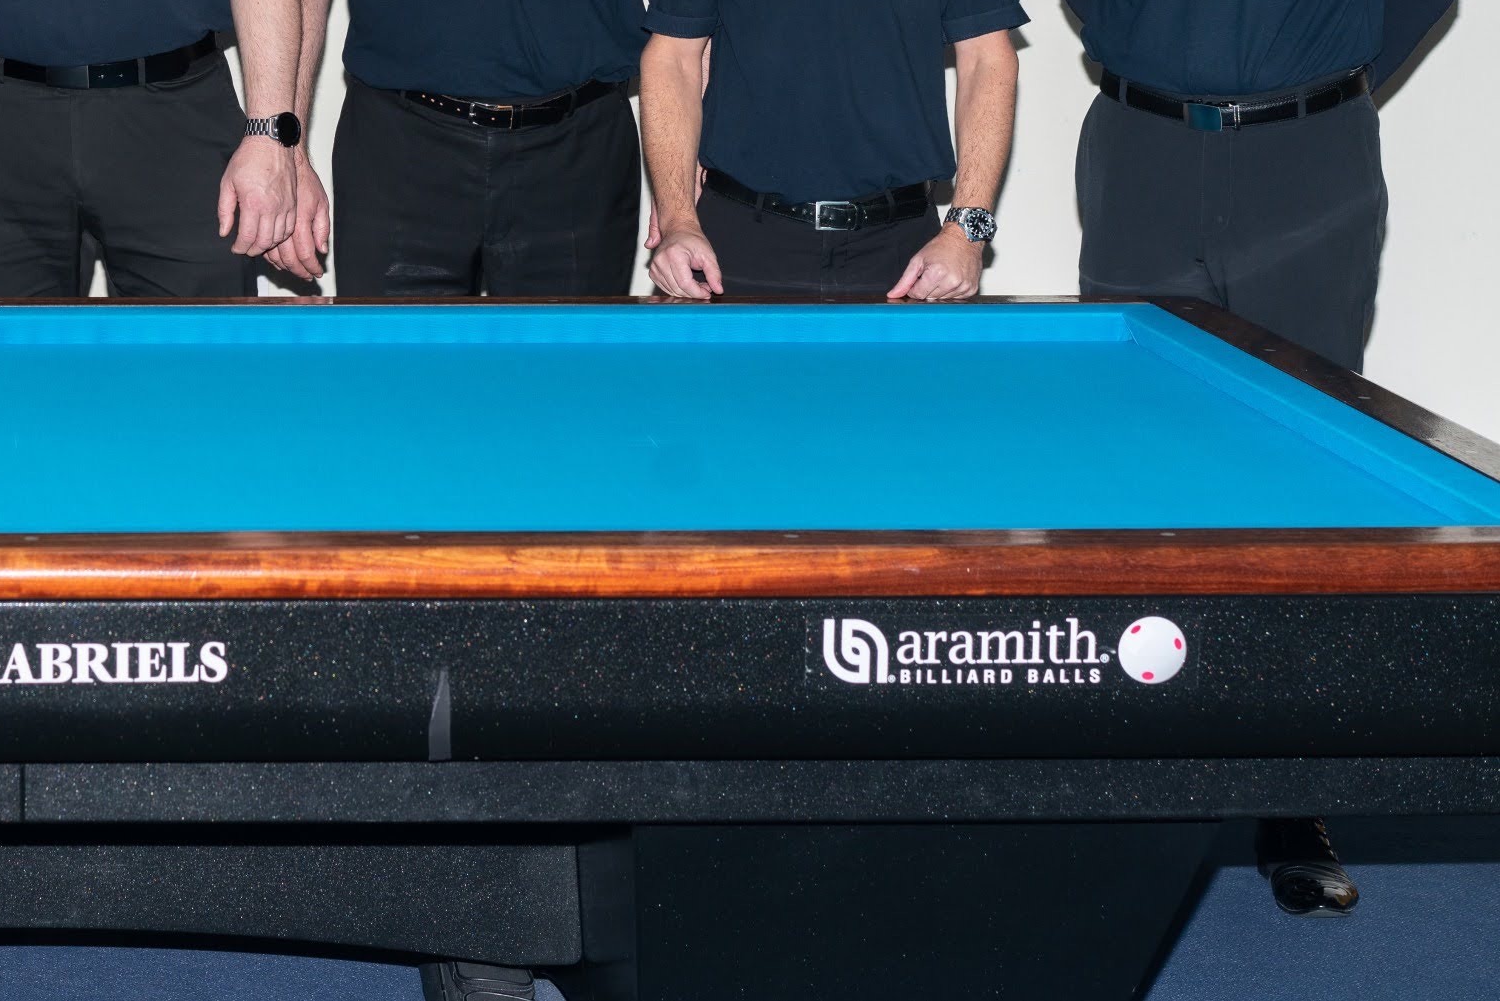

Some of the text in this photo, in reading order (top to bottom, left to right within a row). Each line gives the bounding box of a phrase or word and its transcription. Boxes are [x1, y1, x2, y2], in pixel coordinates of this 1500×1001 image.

[896, 618, 1100, 665] aramith
[899, 668, 1101, 685] BILLIARD BALLS
